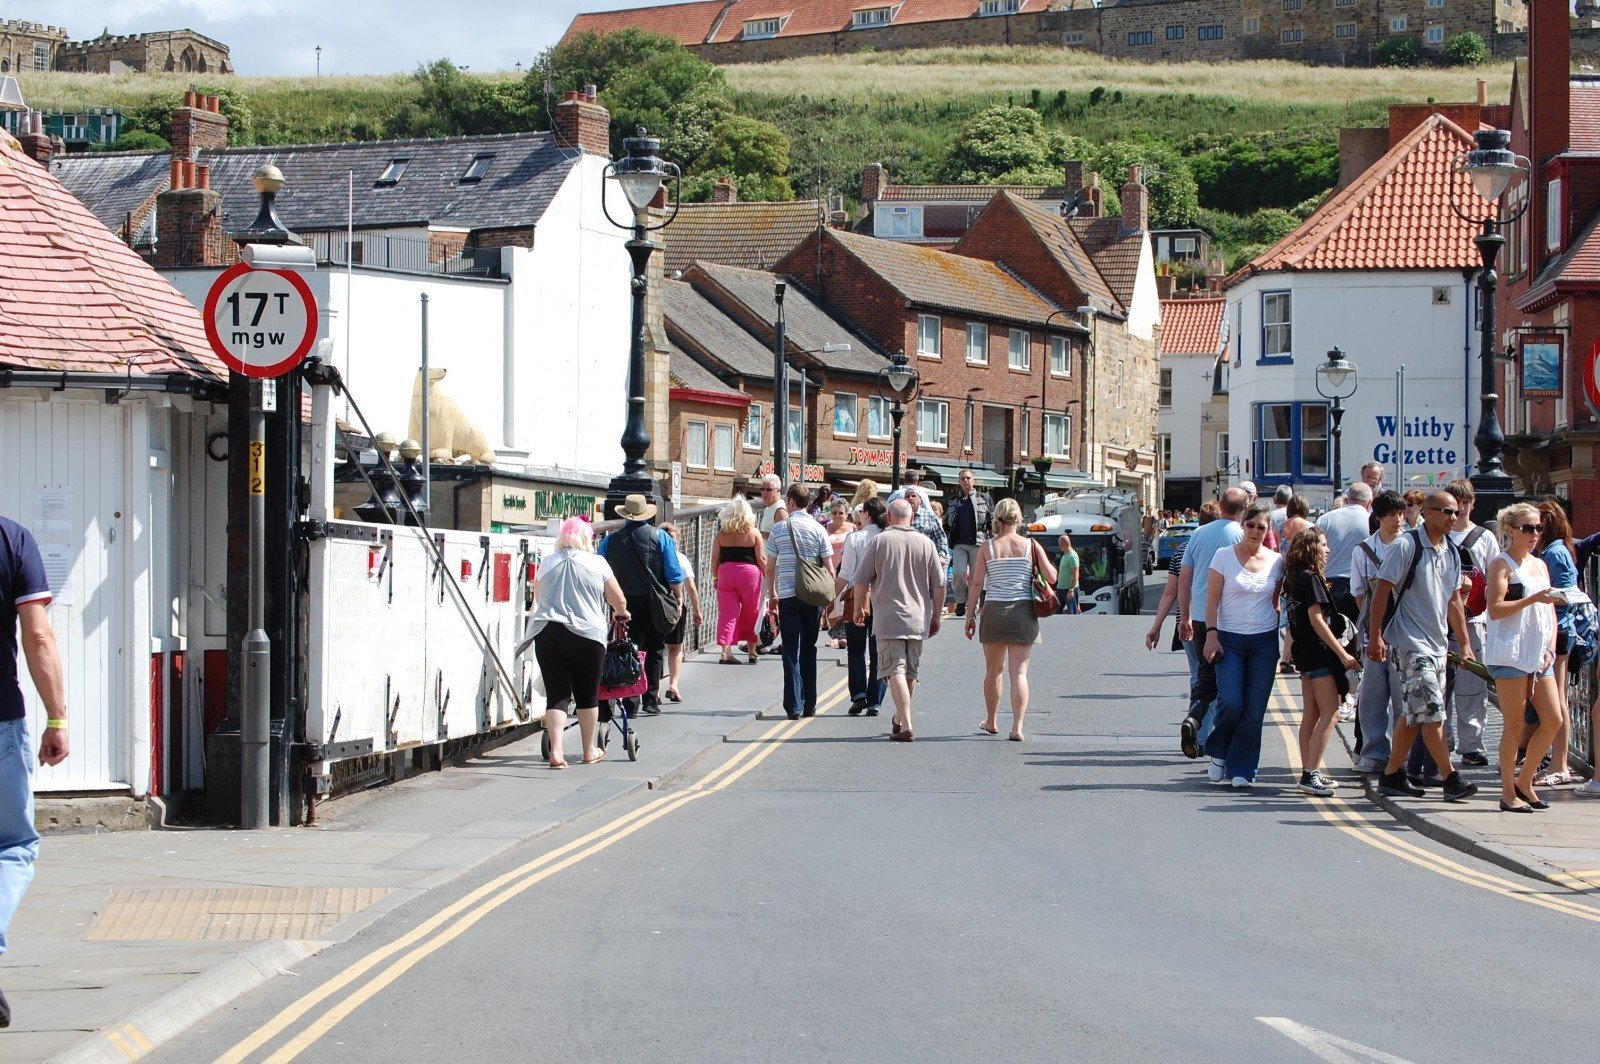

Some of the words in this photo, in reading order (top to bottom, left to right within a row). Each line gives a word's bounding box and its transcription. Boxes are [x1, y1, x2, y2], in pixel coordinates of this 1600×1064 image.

[232, 331, 285, 349] mgw
[1375, 415, 1455, 442] Whitby
[850, 447, 908, 467] TOYMASTR
